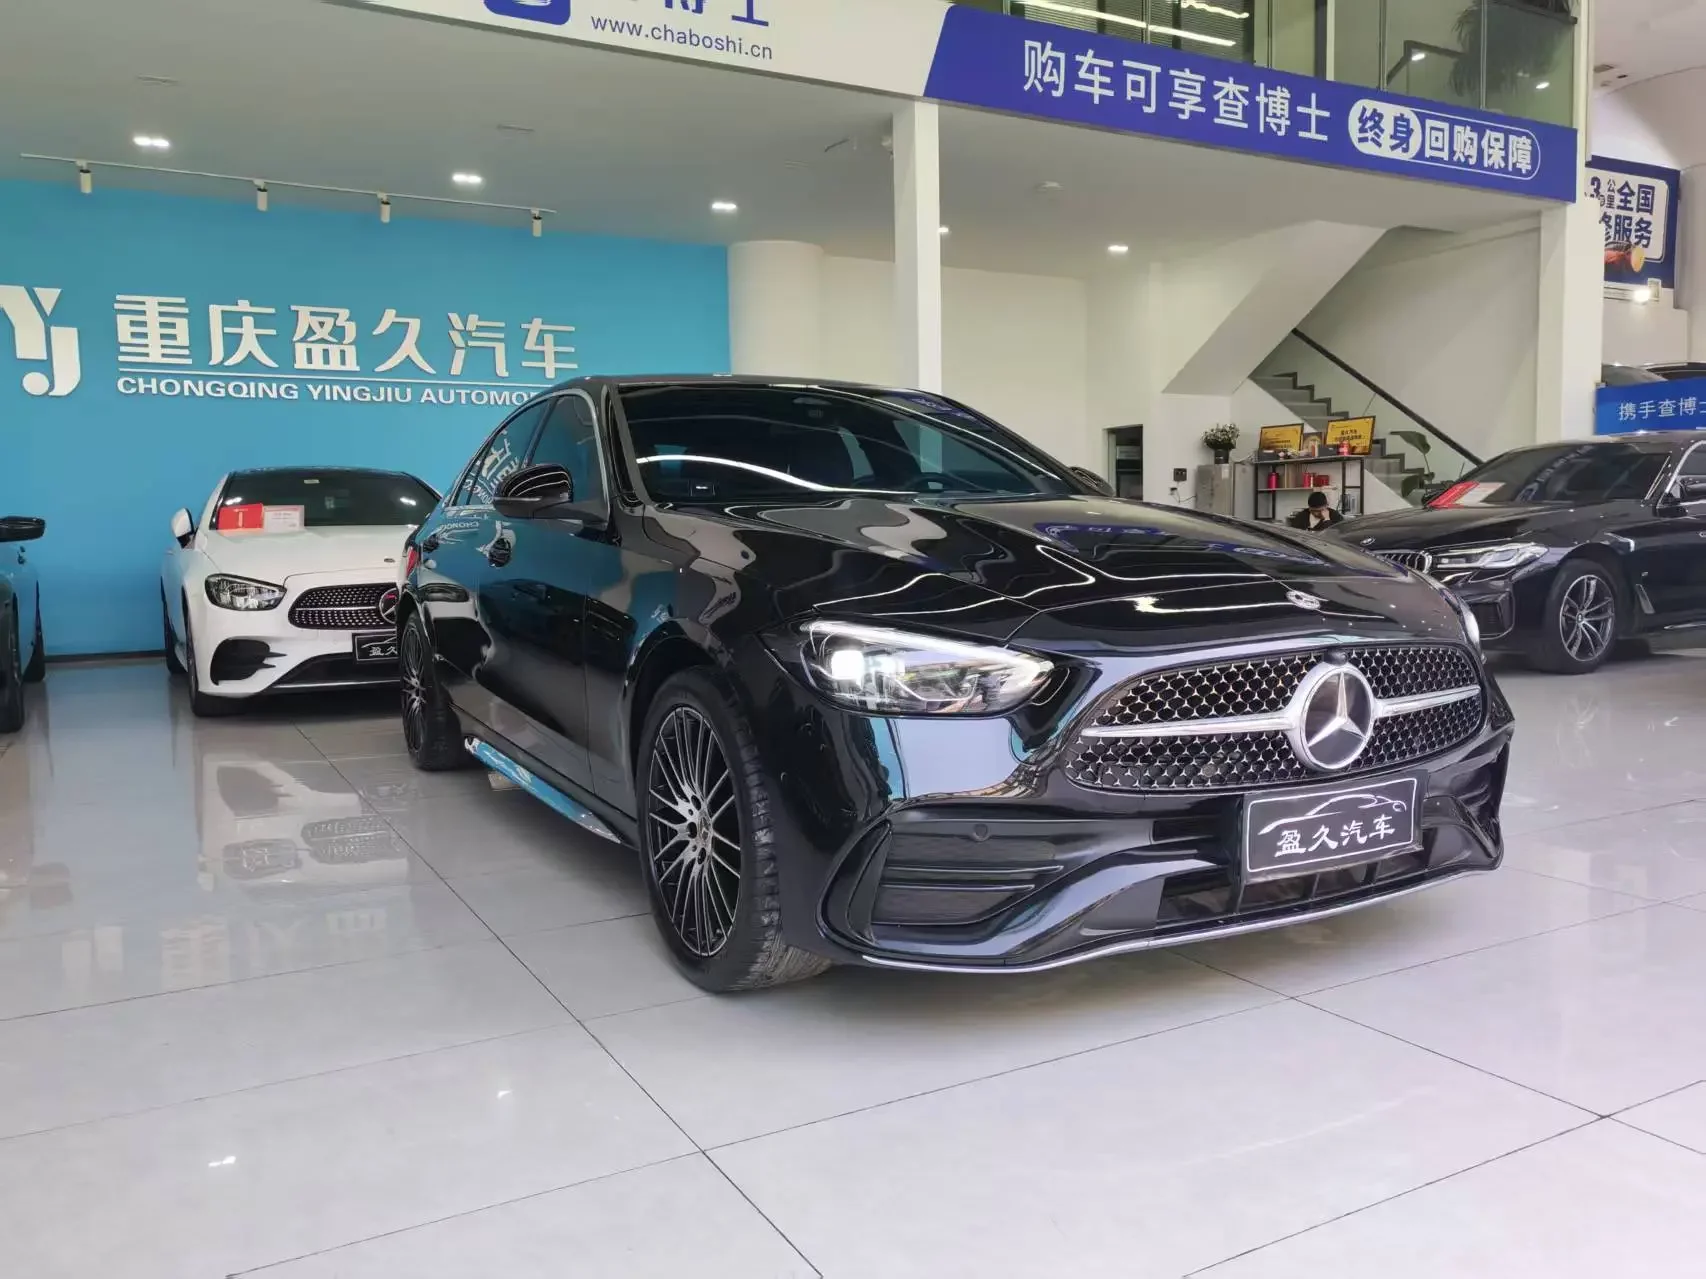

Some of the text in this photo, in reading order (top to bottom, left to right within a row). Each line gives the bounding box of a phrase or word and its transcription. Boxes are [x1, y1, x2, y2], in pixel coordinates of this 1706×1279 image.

[591, 16, 773, 59] www.chaboshi.cn
[1023, 39, 1331, 141] 购车可享查博士
[114, 294, 579, 379] 重庆盈久汽车
[117, 376, 299, 399] CHONGQING
[306, 383, 412, 402] YINGJIU
[1275, 814, 1396, 857] 盈久汽车
